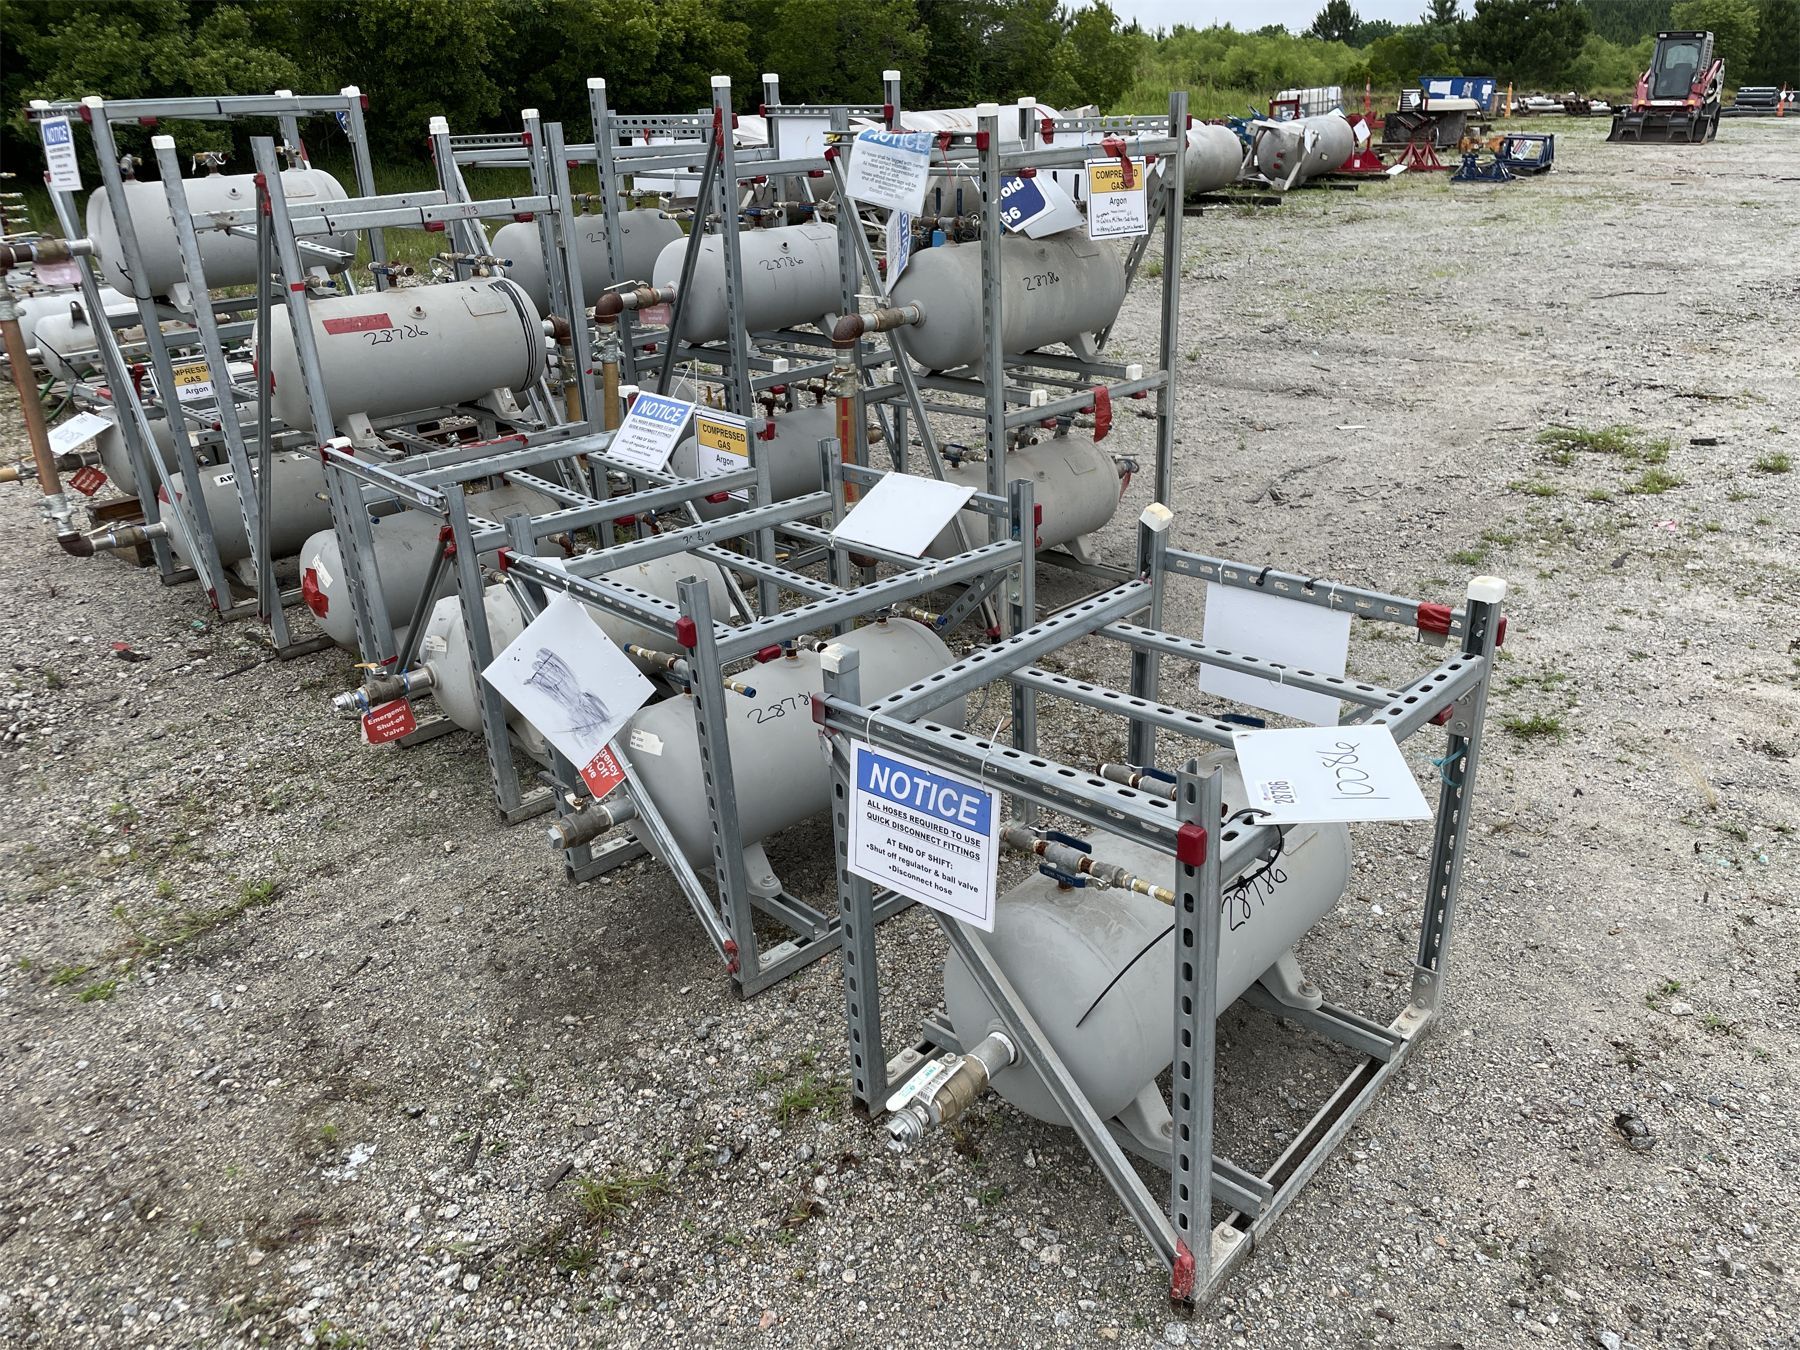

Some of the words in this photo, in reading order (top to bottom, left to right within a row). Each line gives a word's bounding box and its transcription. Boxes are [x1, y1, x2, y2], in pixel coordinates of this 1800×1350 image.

[868, 131, 927, 151] NOTICE
[1096, 170, 1138, 179] COMPRED
[1001, 176, 1024, 200] old
[1111, 182, 1124, 190] GAS
[1110, 197, 1127, 206] Argon
[174, 366, 207, 376] MPRESS
[186, 386, 208, 394] Argon
[638, 400, 684, 422] NOTICE
[702, 424, 745, 442] COMPRESSED
[718, 440, 731, 450] GAS
[716, 454, 734, 466] Argon
[368, 705, 406, 725] Emergency
[377, 715, 405, 730] Shut-off
[383, 726, 404, 737] Valve
[586, 763, 596, 778] lve
[593, 756, 610, 778] t-Off
[600, 749, 619, 776] gency
[869, 762, 980, 826] NOTICE
[1268, 781, 1294, 804] 28786
[867, 799, 880, 810] ALL
[883, 806, 908, 820] HOSES
[909, 816, 949, 835] REQUIRED
[951, 830, 962, 840] TO
[964, 836, 981, 847] USE
[867, 812, 890, 826] QUICK
[892, 821, 941, 846] DISCONNECT
[943, 840, 980, 861] FITTINGS
[887, 838, 896, 847] AT
[898, 842, 914, 854] END
[916, 848, 926, 858] OF
[928, 854, 953, 870] SHIFT:
[887, 850, 897, 861] off
[898, 855, 932, 875] regulator
[934, 869, 940, 877] &
[942, 872, 956, 884] ball
[958, 879, 979, 893] valve
[934, 882, 953, 896] hose
[1222, 867, 1287, 931] 28786
